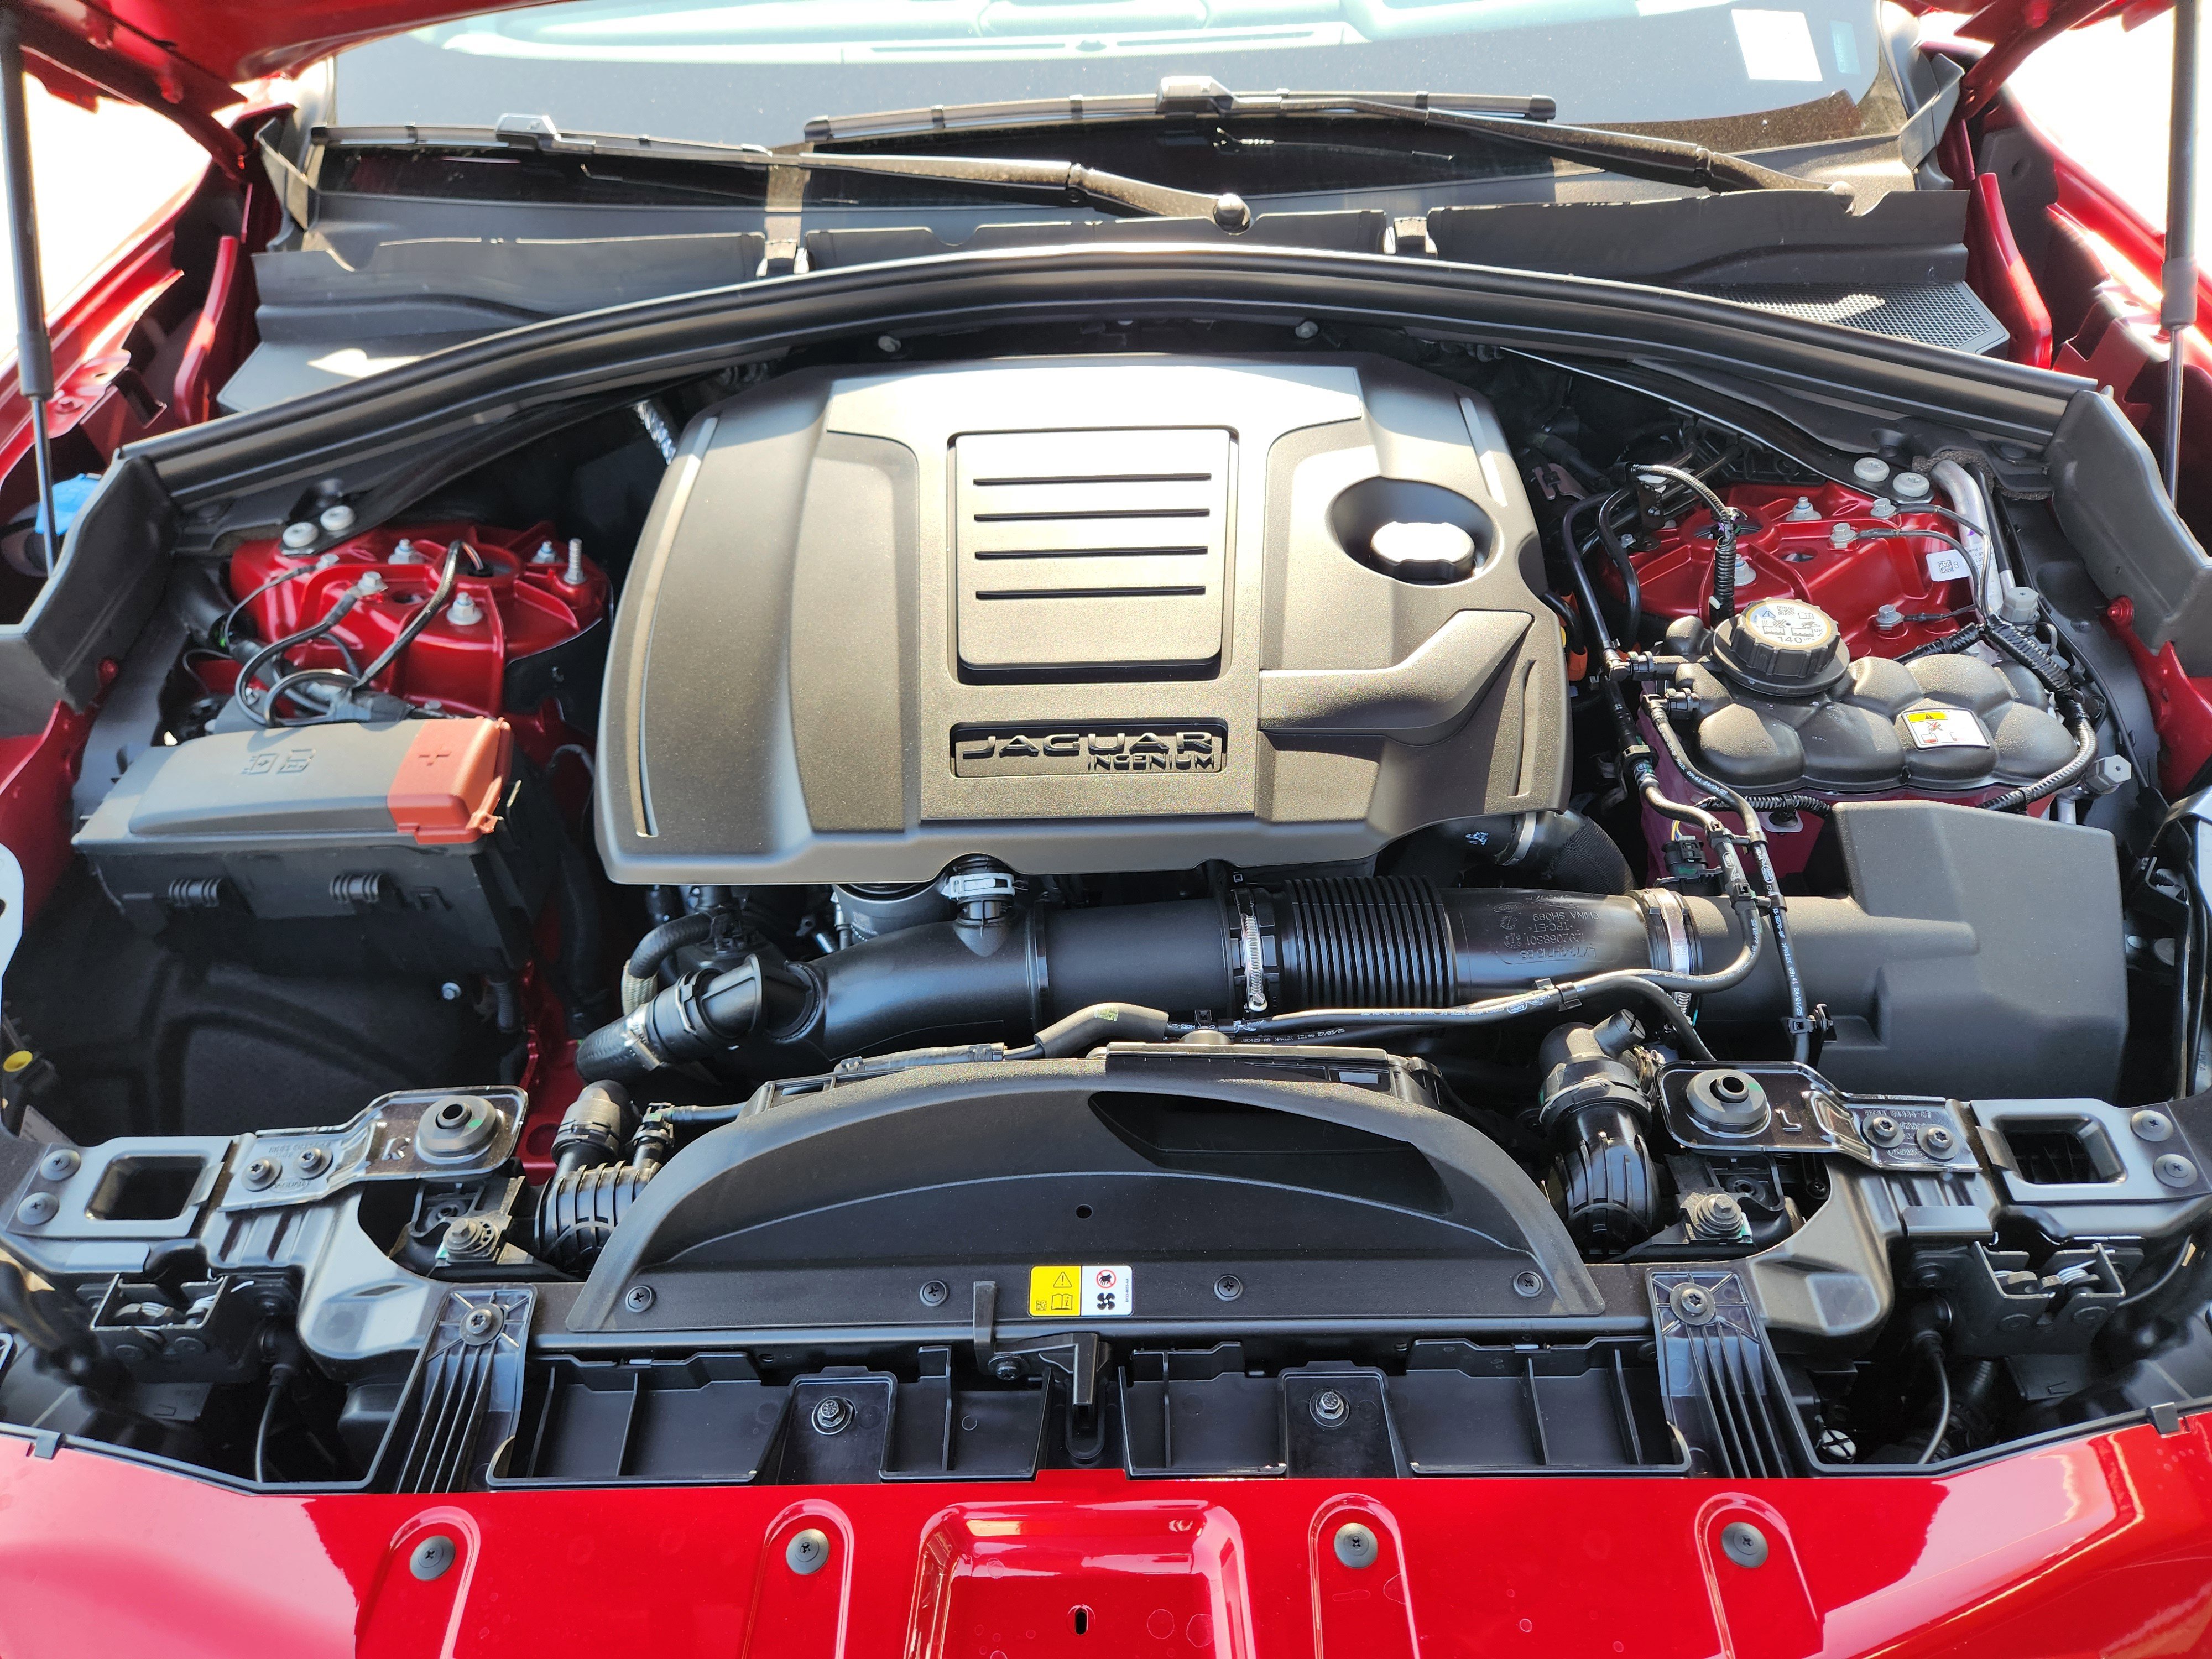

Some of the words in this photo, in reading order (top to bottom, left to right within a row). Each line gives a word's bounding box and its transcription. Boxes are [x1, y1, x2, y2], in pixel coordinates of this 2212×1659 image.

[963, 732, 1214, 758] JAGUAR
[1087, 753, 1215, 771] INGENIUM
[1532, 912, 1566, 921] SH089
[1569, 911, 1599, 920] CHINA
[1788, 967, 1798, 985] 09:41
[1793, 987, 1804, 1016] 24/04/25
[1317, 1027, 1346, 1037] 27/03/25
